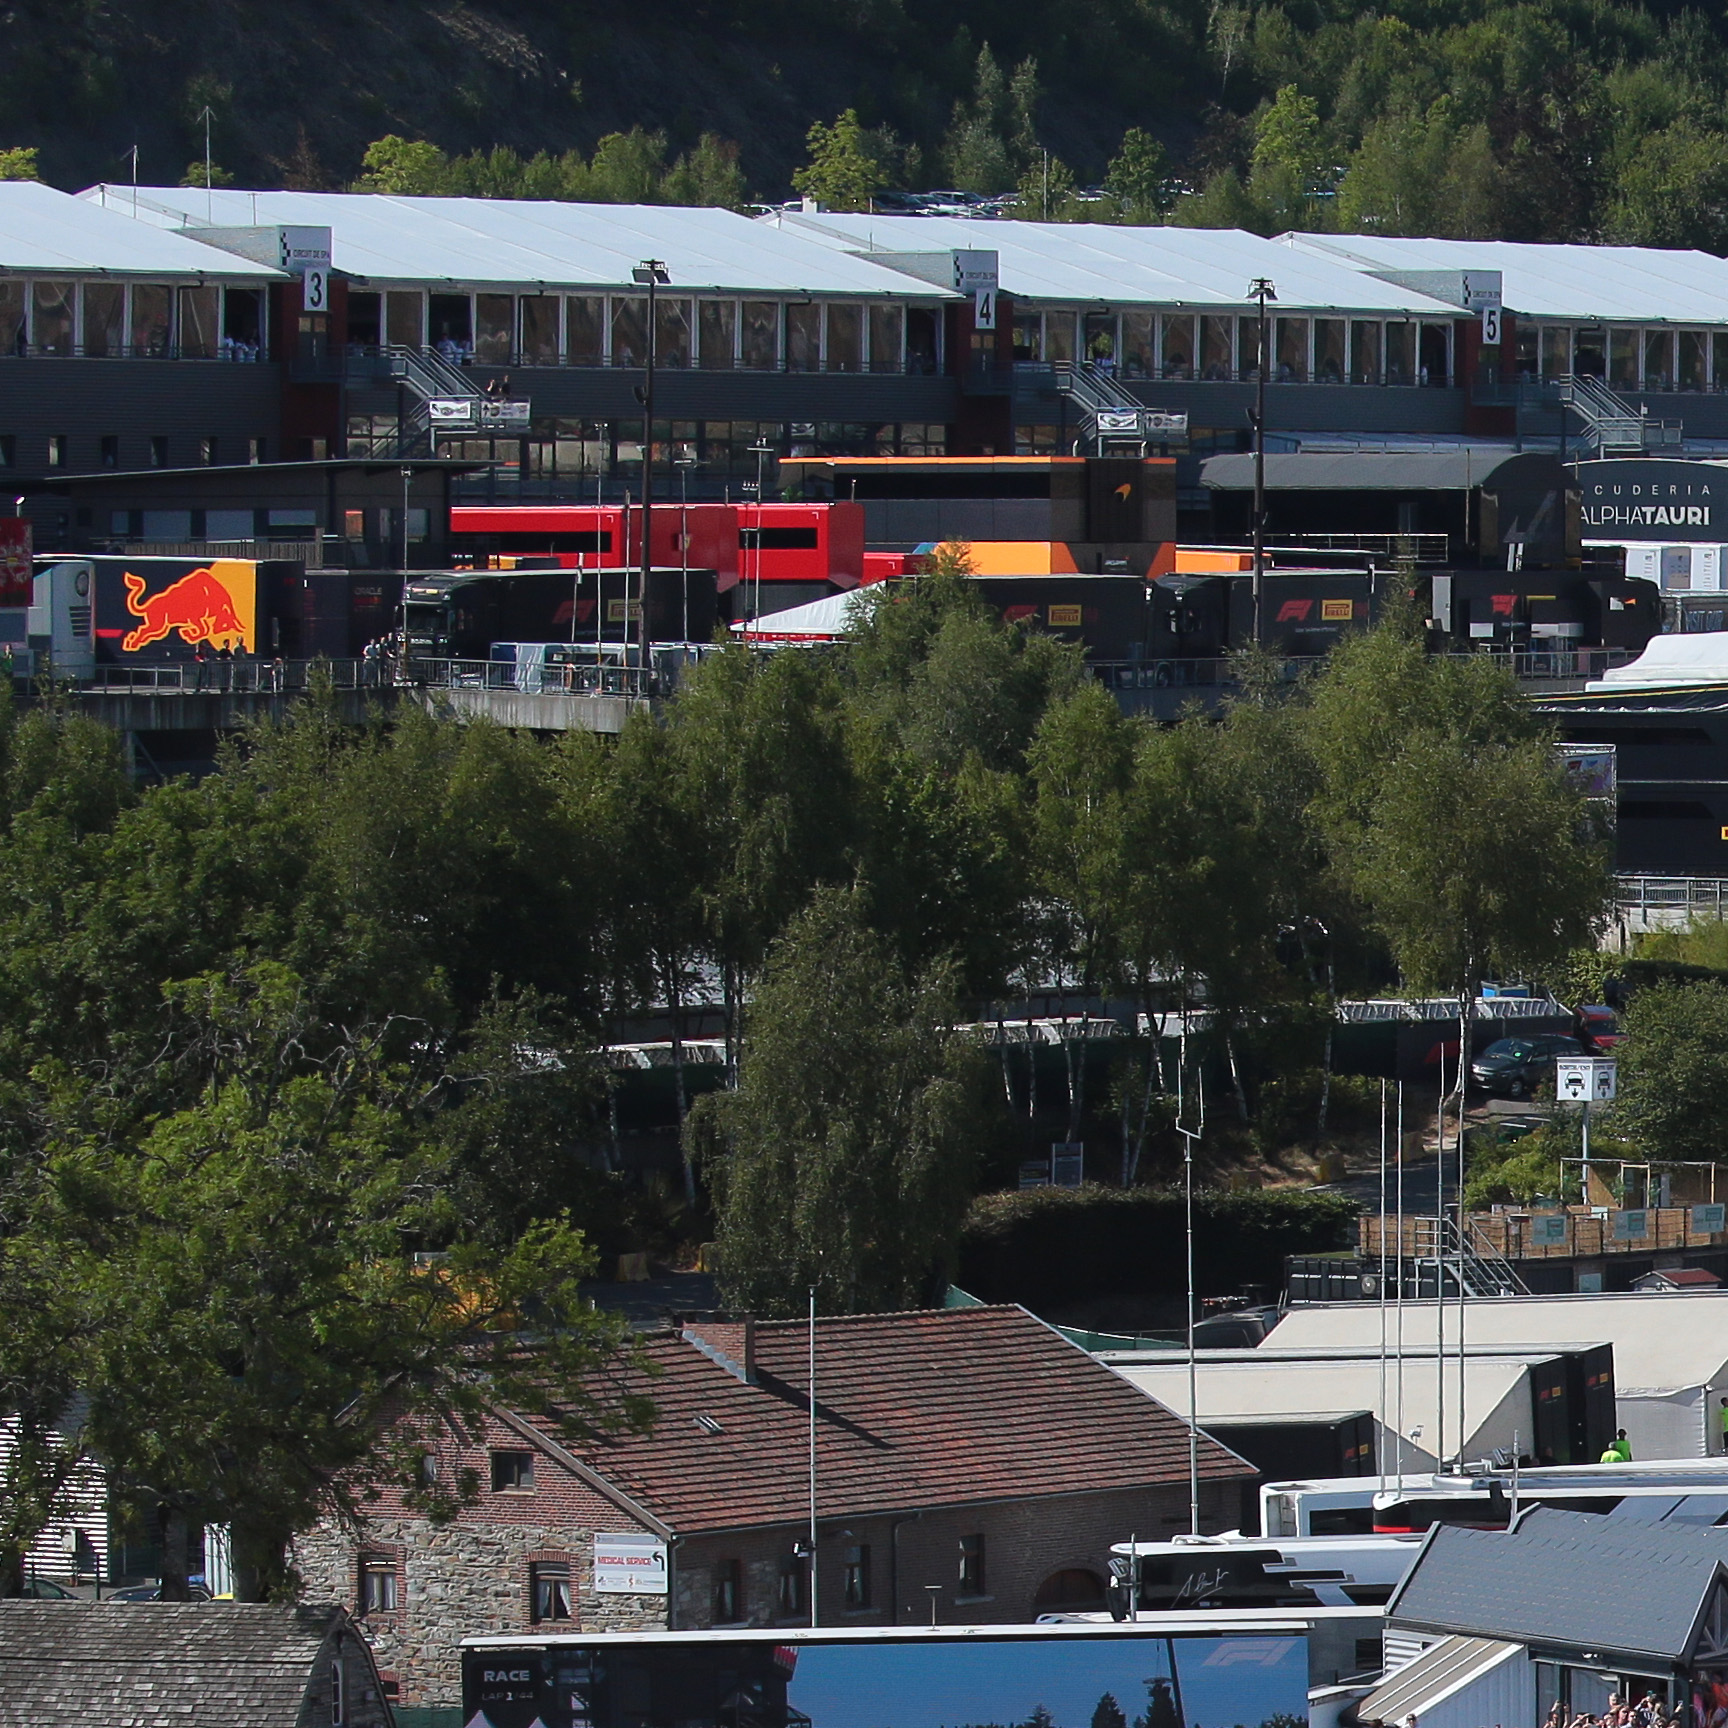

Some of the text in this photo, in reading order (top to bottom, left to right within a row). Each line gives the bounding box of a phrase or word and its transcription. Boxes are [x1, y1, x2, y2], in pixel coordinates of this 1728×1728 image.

[310, 272, 322, 308] 3
[979, 292, 992, 325] 4
[1486, 310, 1498, 342] 5
[1581, 485, 1710, 496] CUDERIA
[1581, 506, 1711, 526] ALPHATAURI
[598, 1557, 652, 1566] MEDICAL SERVICE
[484, 1670, 530, 1682] RACE
